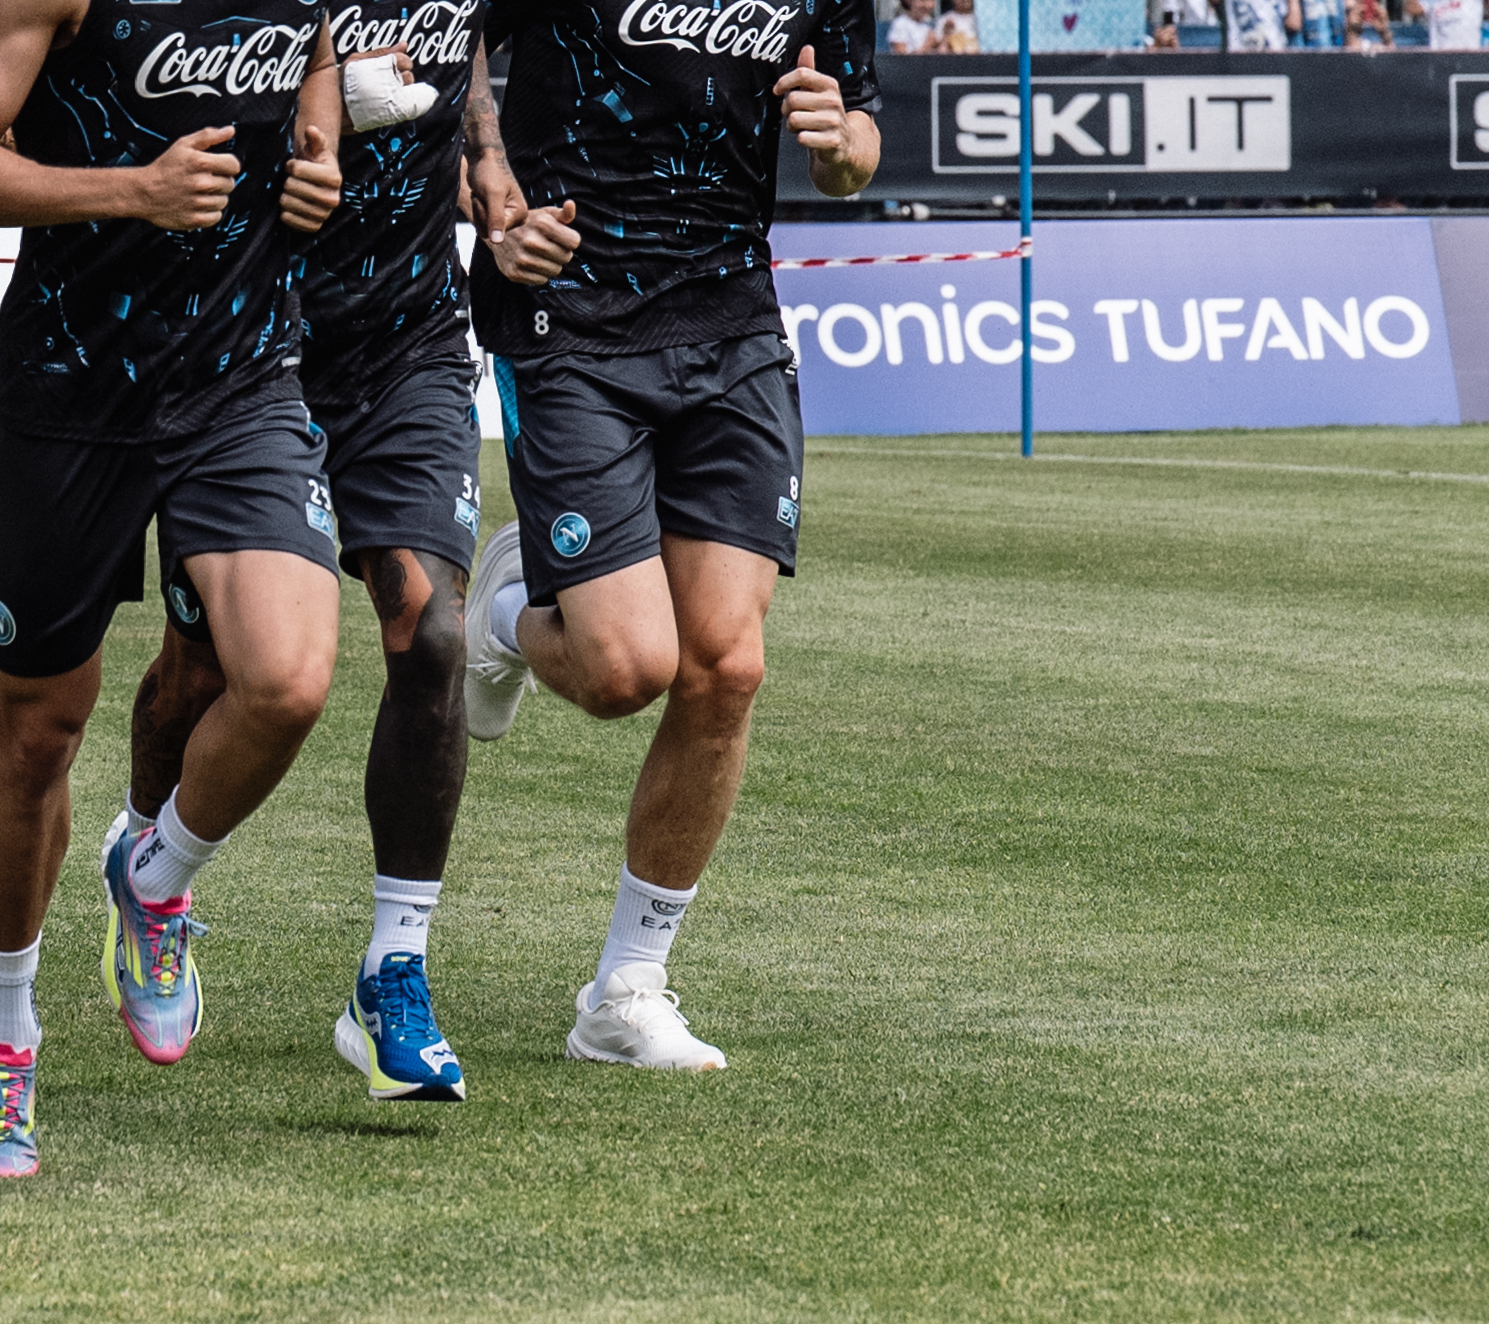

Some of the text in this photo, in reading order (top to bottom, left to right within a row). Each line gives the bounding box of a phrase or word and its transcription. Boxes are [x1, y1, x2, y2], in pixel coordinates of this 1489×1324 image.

[135, 23, 319, 99] Coca-Cola
[955, 92, 1273, 158] SKI.IT
[534, 310, 550, 335] 8
[1093, 295, 1431, 363] TUFANO
[308, 479, 332, 511] 23
[789, 475, 799, 501] 8
